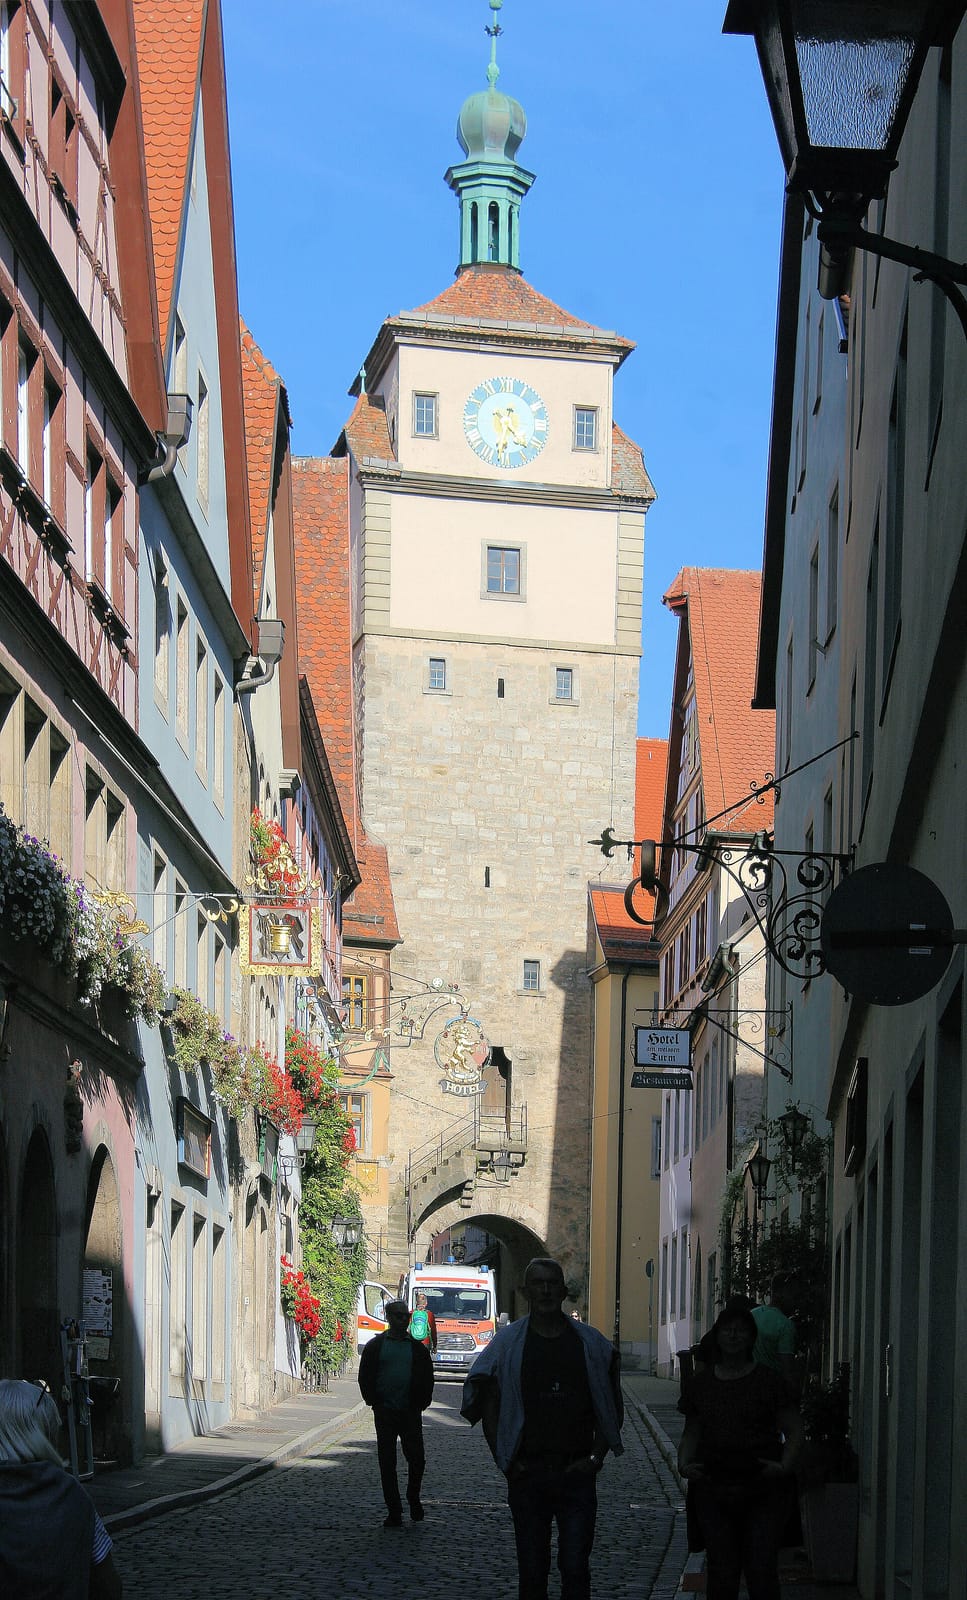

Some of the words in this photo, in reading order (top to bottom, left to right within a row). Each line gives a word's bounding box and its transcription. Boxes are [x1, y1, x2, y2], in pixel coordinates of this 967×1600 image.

[647, 1032, 679, 1045] Hotel
[650, 1053, 676, 1061] Turm
[636, 1074, 688, 1086] Restaurant
[445, 1081, 483, 1094] HOTEL
